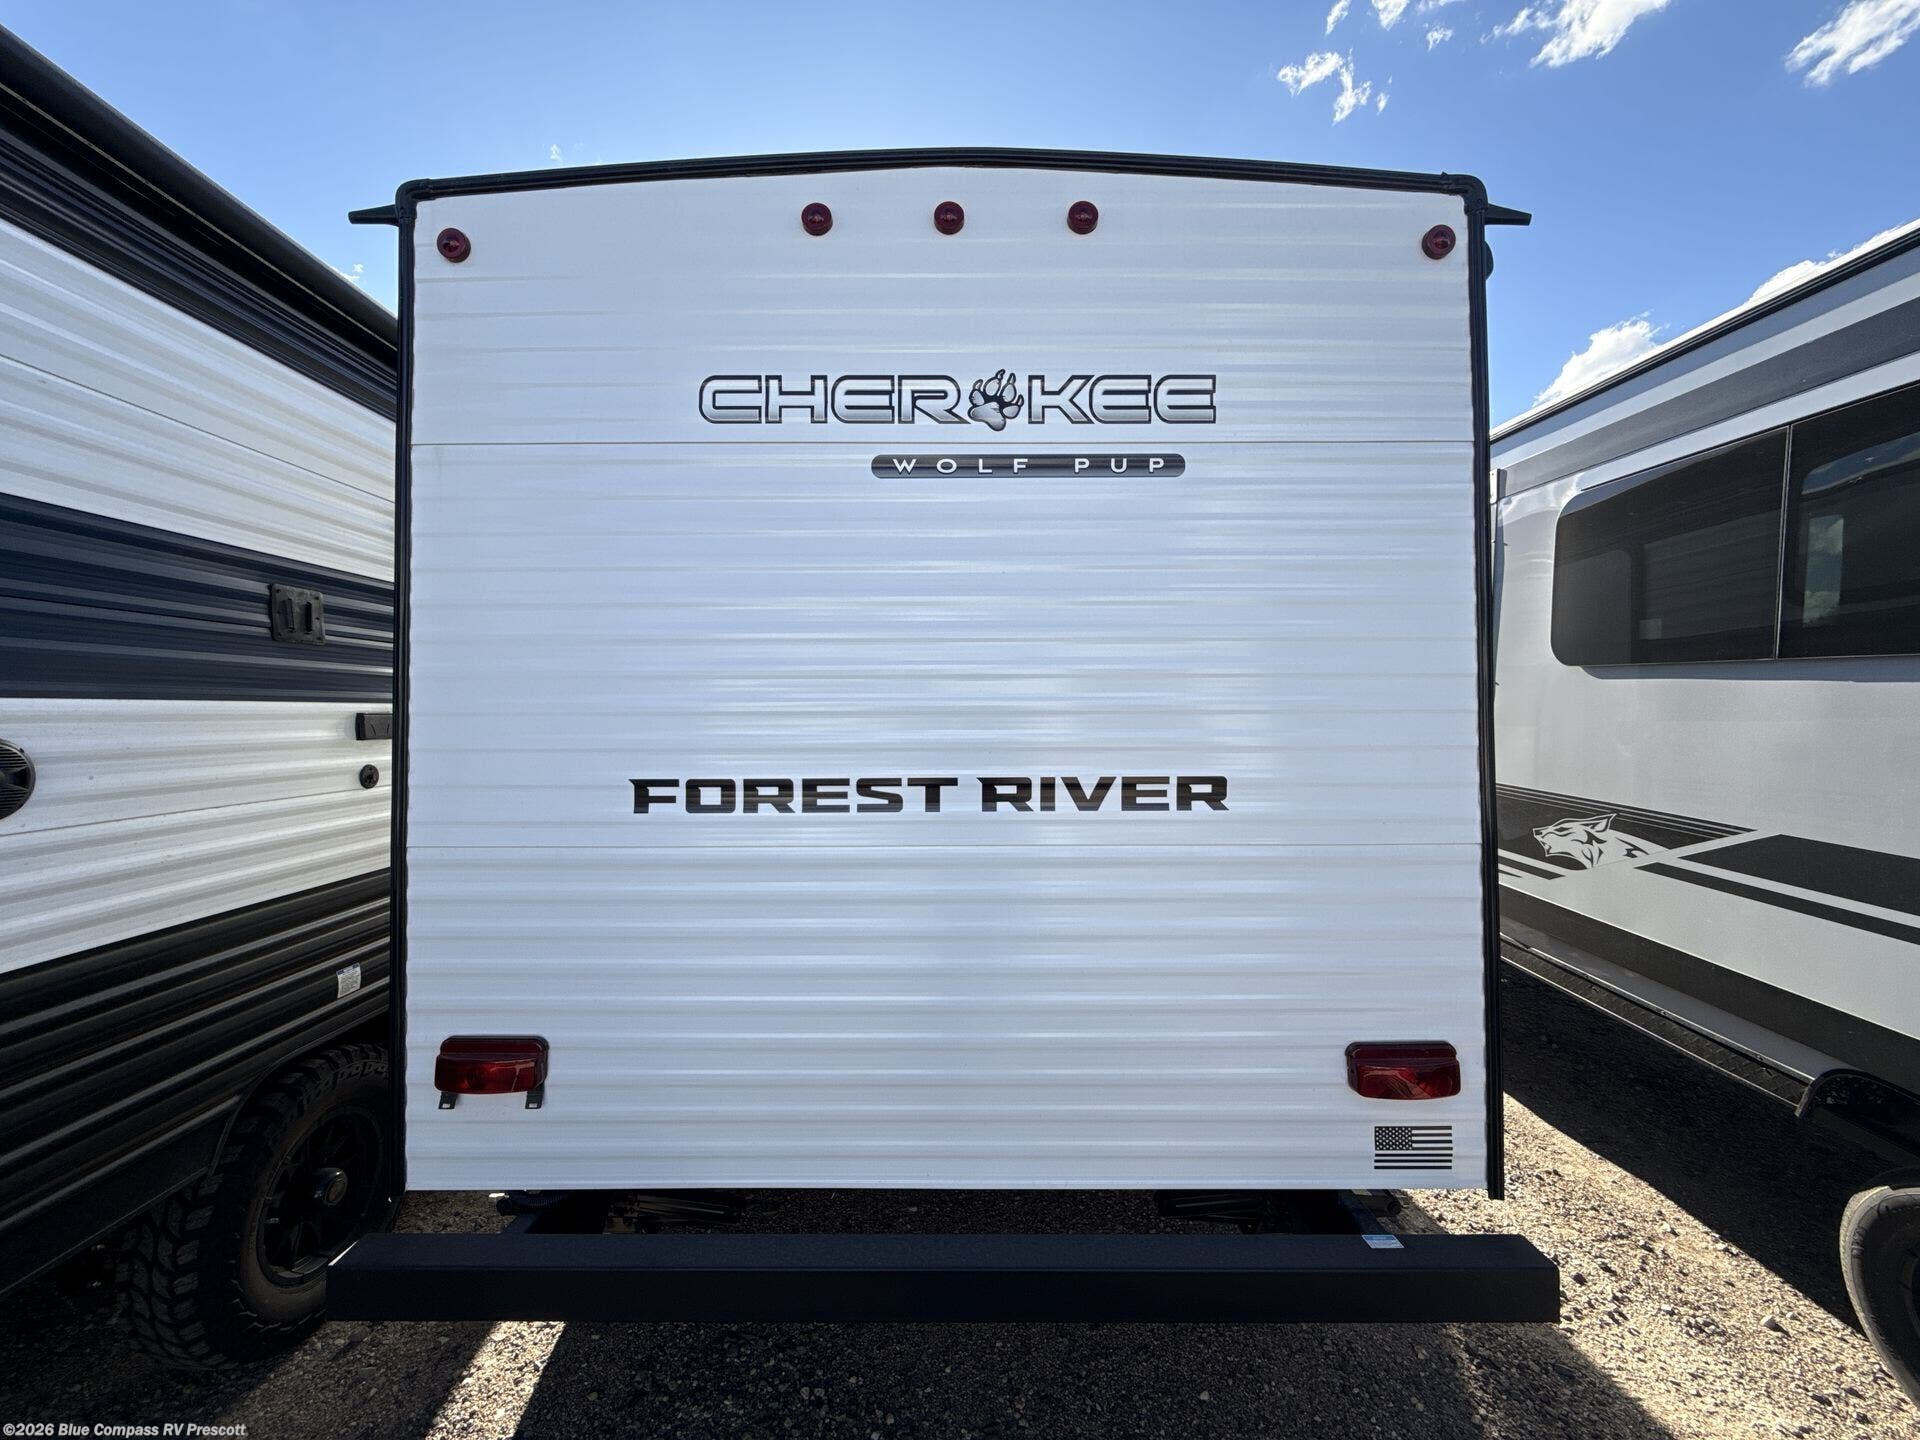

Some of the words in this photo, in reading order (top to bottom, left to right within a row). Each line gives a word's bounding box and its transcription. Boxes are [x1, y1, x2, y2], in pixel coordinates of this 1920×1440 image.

[699, 369, 1217, 432] CHERKEE
[892, 457, 1029, 475] WOLF
[1073, 457, 1165, 474] PUP
[628, 777, 959, 815] FOREST
[976, 775, 1230, 813] RIVER
